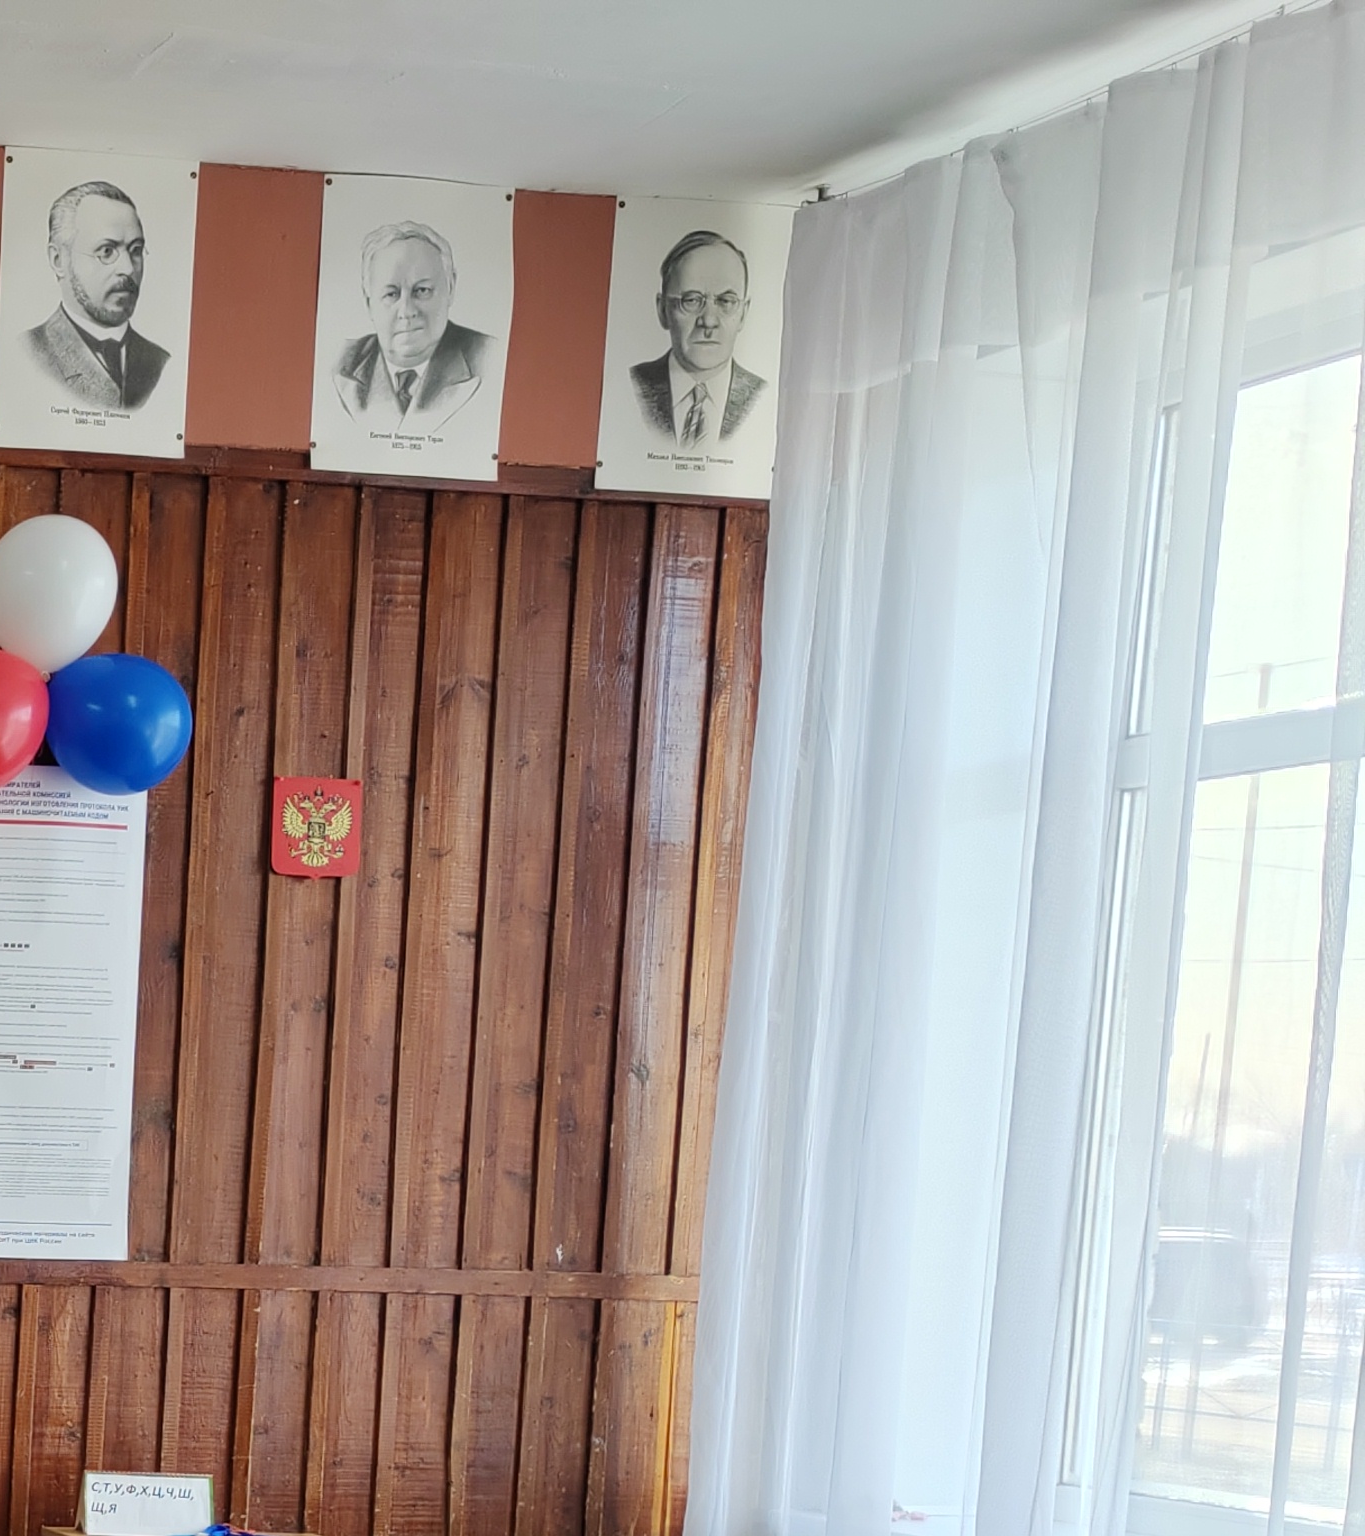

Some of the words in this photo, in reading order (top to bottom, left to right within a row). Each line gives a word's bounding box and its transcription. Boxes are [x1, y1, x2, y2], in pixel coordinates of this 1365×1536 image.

[31, 801, 79, 809] ИЗГОТОВЛЕНИЯ
[79, 803, 115, 811] ПРОТОКОЛА
[87, 812, 110, 820] КОДОМ
[91, 1481, 194, 1501] С,Т,У,Ф,Х,Ц,Ч,Ш,
[90, 1501, 117, 1515] Щ,Я
